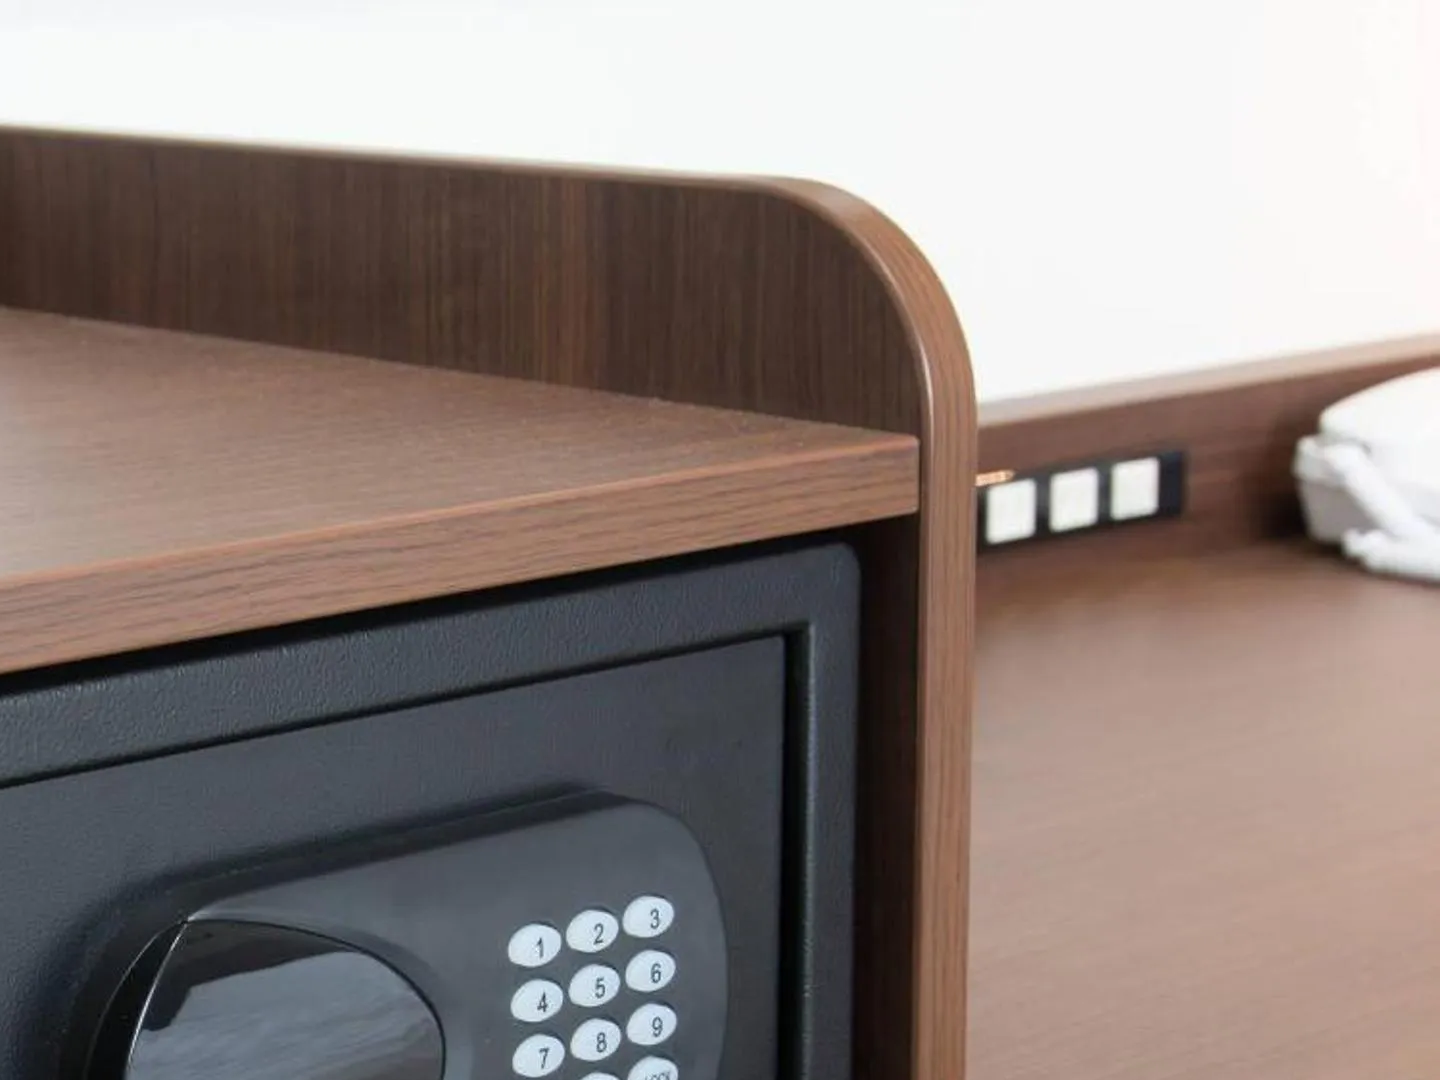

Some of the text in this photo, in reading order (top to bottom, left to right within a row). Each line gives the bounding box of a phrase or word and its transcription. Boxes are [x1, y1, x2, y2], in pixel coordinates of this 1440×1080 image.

[593, 922, 605, 945] 2
[649, 907, 660, 930] 3
[536, 962, 662, 1013] 4 5 6
[538, 1016, 663, 1069] 7 8 9
